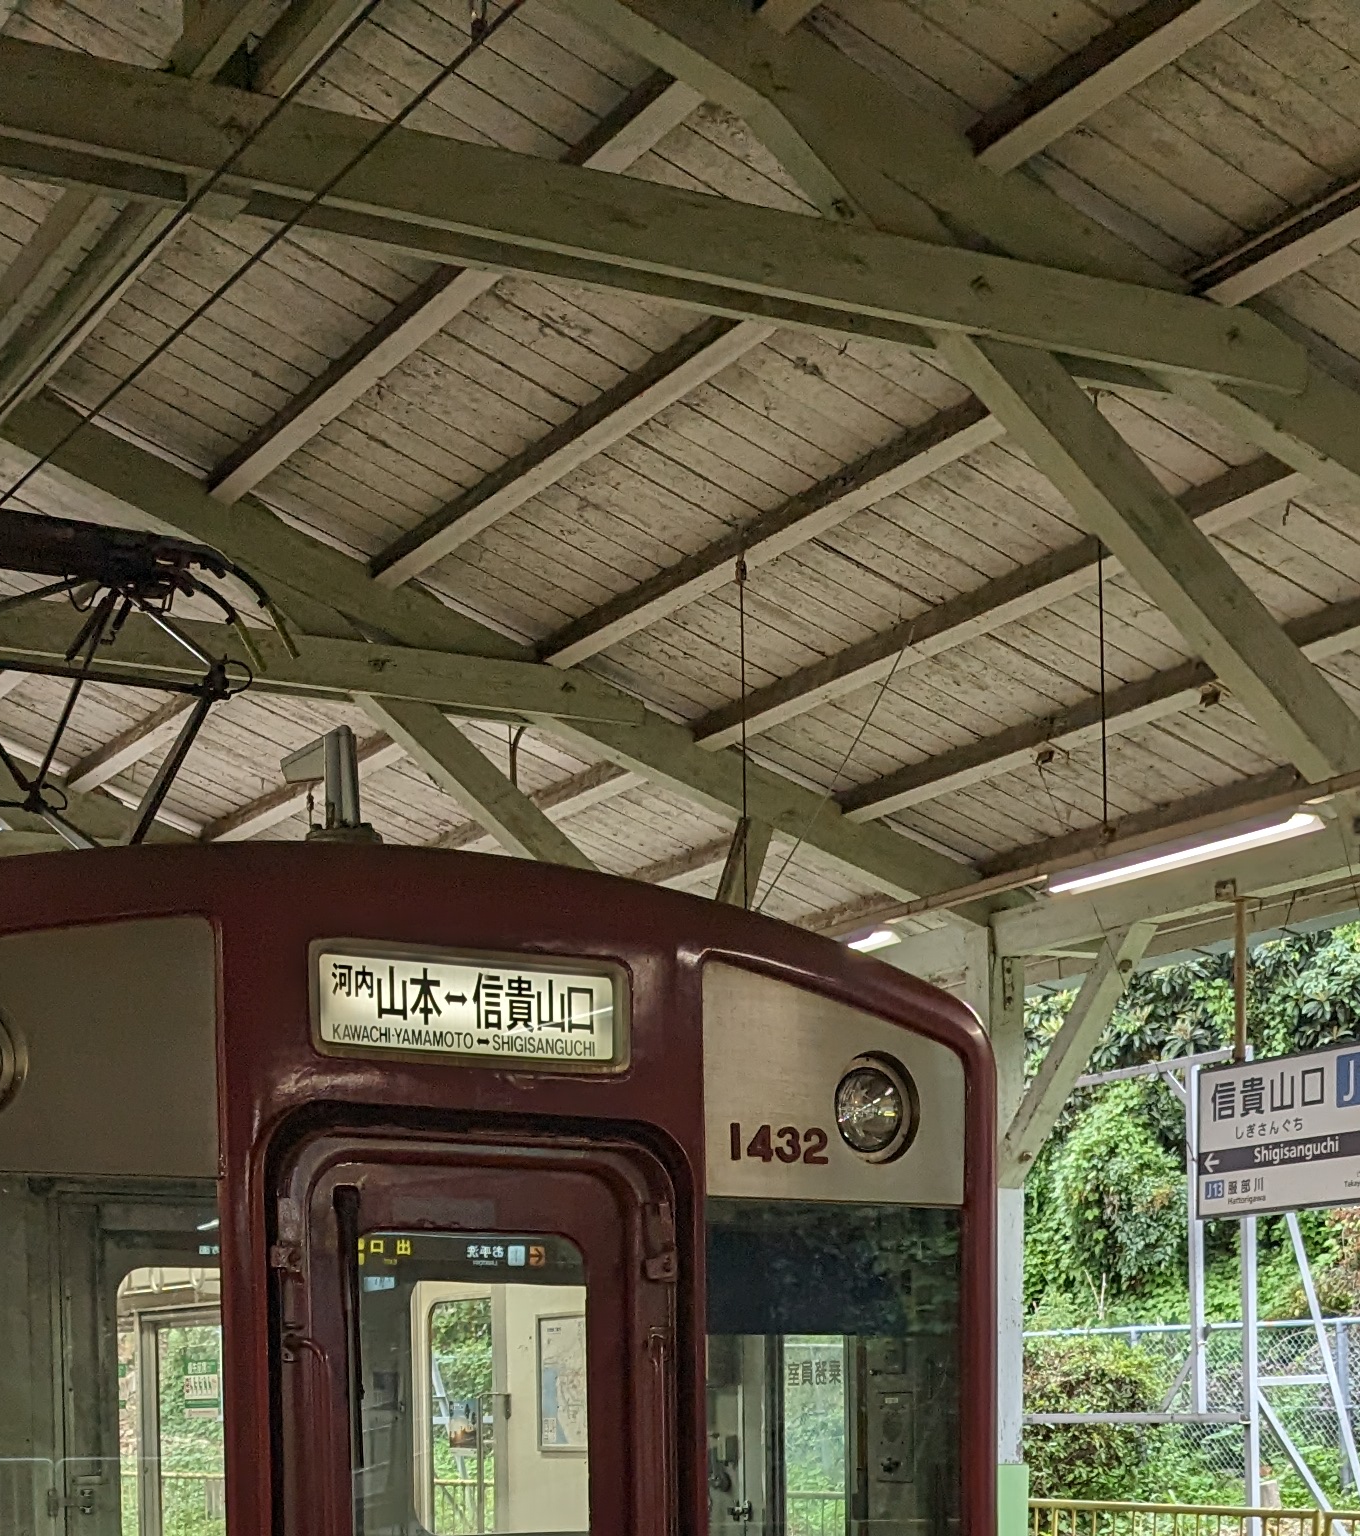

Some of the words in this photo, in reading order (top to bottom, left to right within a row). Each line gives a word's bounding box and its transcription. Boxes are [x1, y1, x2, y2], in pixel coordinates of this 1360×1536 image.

[331, 962, 443, 1026] 河内山本
[472, 972, 595, 1035] 信貴山口
[492, 1033, 596, 1058] SHIGISANGUCHI
[1211, 1066, 1325, 1122] 信貴山口
[1235, 1116, 1304, 1141] しぎさんぐち
[730, 1122, 829, 1164] 1432
[1254, 1137, 1339, 1164] Shigisanguchi
[1206, 1181, 1224, 1199] J13
